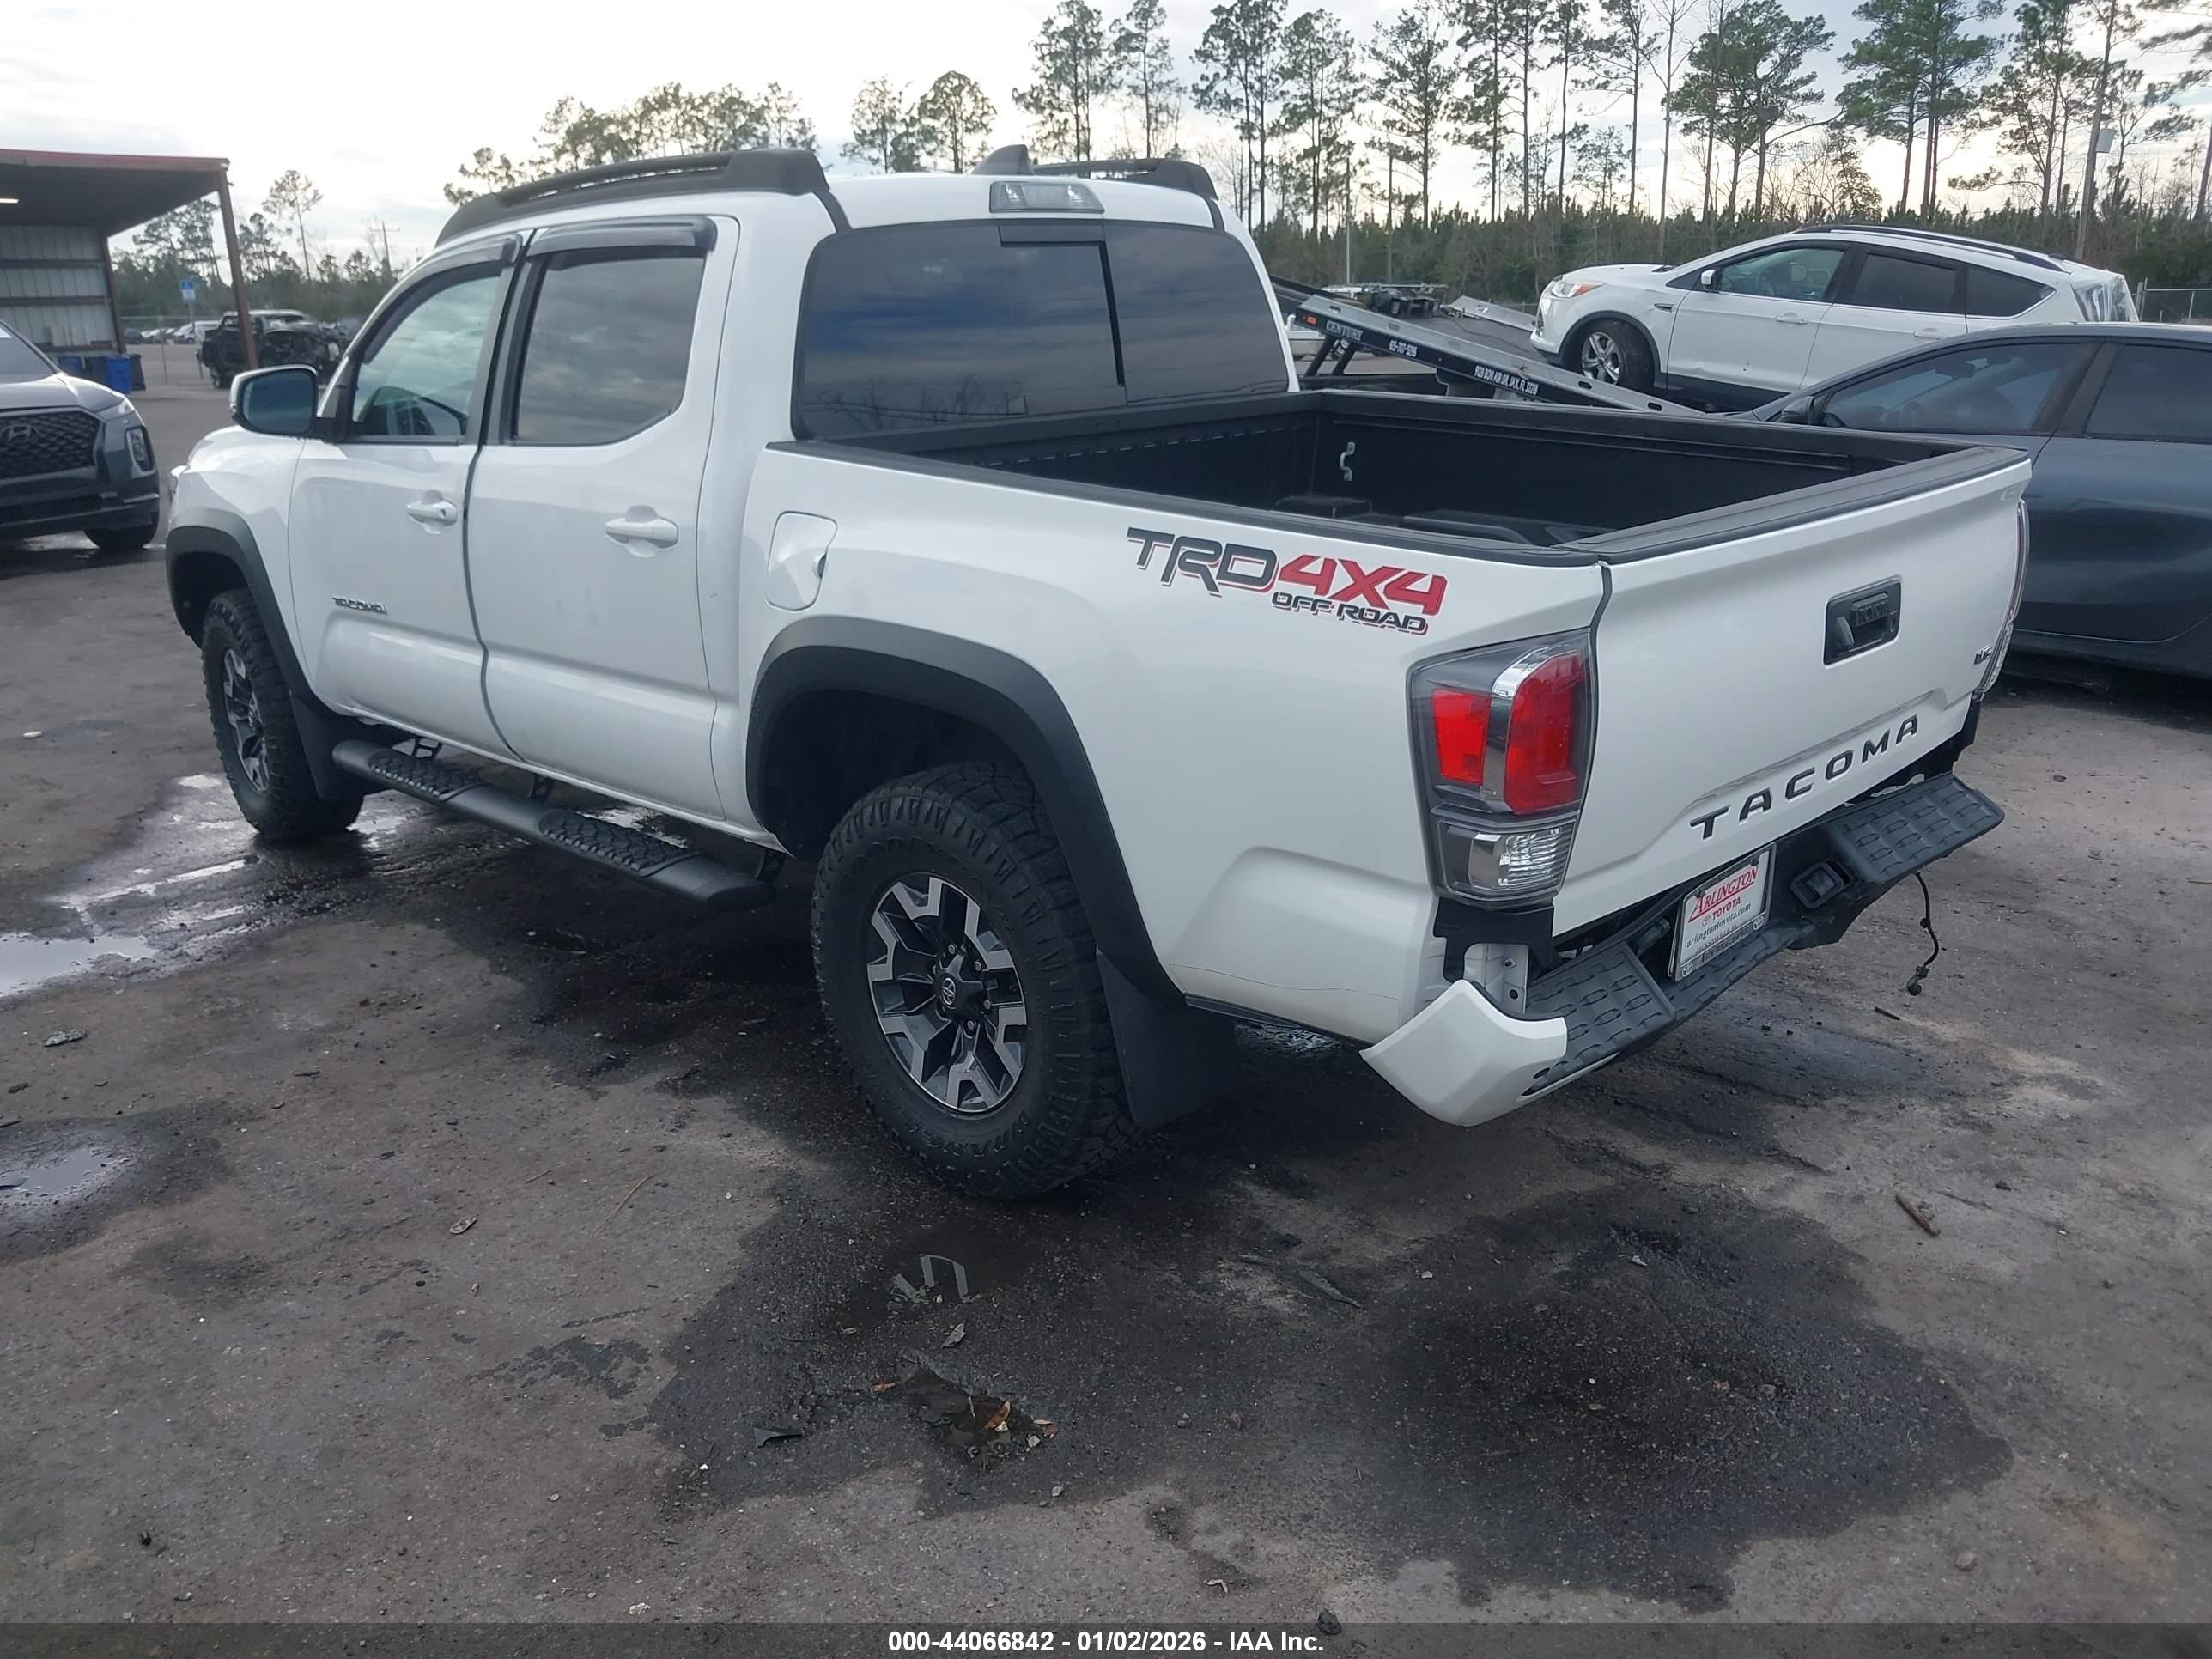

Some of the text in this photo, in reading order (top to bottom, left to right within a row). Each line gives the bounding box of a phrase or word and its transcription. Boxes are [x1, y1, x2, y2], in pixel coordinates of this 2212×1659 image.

[1326, 320, 1364, 341] CENTURY
[1126, 526, 1279, 598] TRD
[1271, 591, 1428, 635] OFF ROAD
[1689, 714, 1918, 841] TACOMA
[1689, 866, 1759, 922] ARLINGTON
[1712, 896, 1741, 921] TOYOTA
